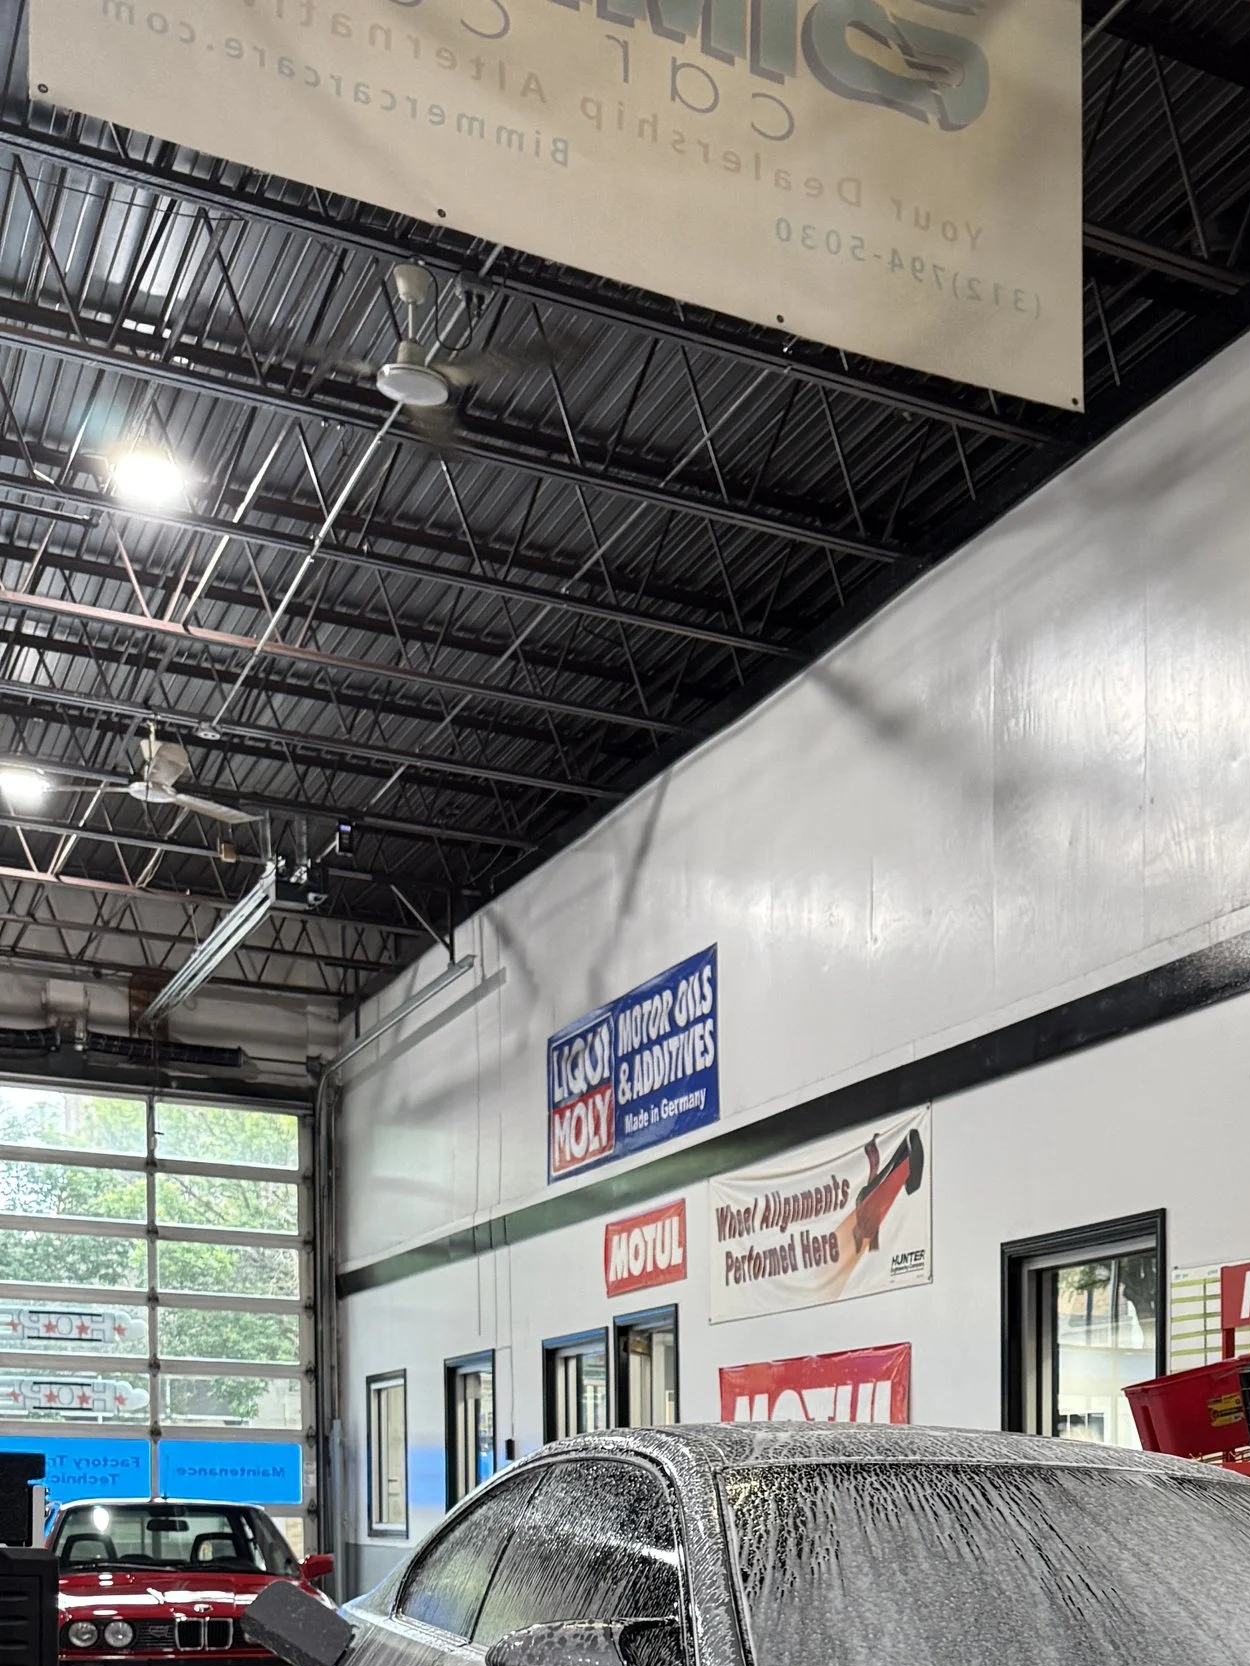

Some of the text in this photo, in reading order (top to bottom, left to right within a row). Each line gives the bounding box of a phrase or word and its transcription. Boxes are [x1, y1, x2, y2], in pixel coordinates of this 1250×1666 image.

[617, 965, 713, 1057] MOTOR OILS
[553, 1022, 611, 1103] LIQUI
[633, 1018, 715, 1100] ADDITIVES
[553, 1089, 612, 1168] MOLY
[625, 1088, 707, 1134] Made in Germany
[716, 1174, 850, 1242] Wheel Alignments
[608, 1216, 684, 1282] MOTUL
[725, 1229, 840, 1287] Performed Here
[891, 1249, 925, 1266] HUNTER
